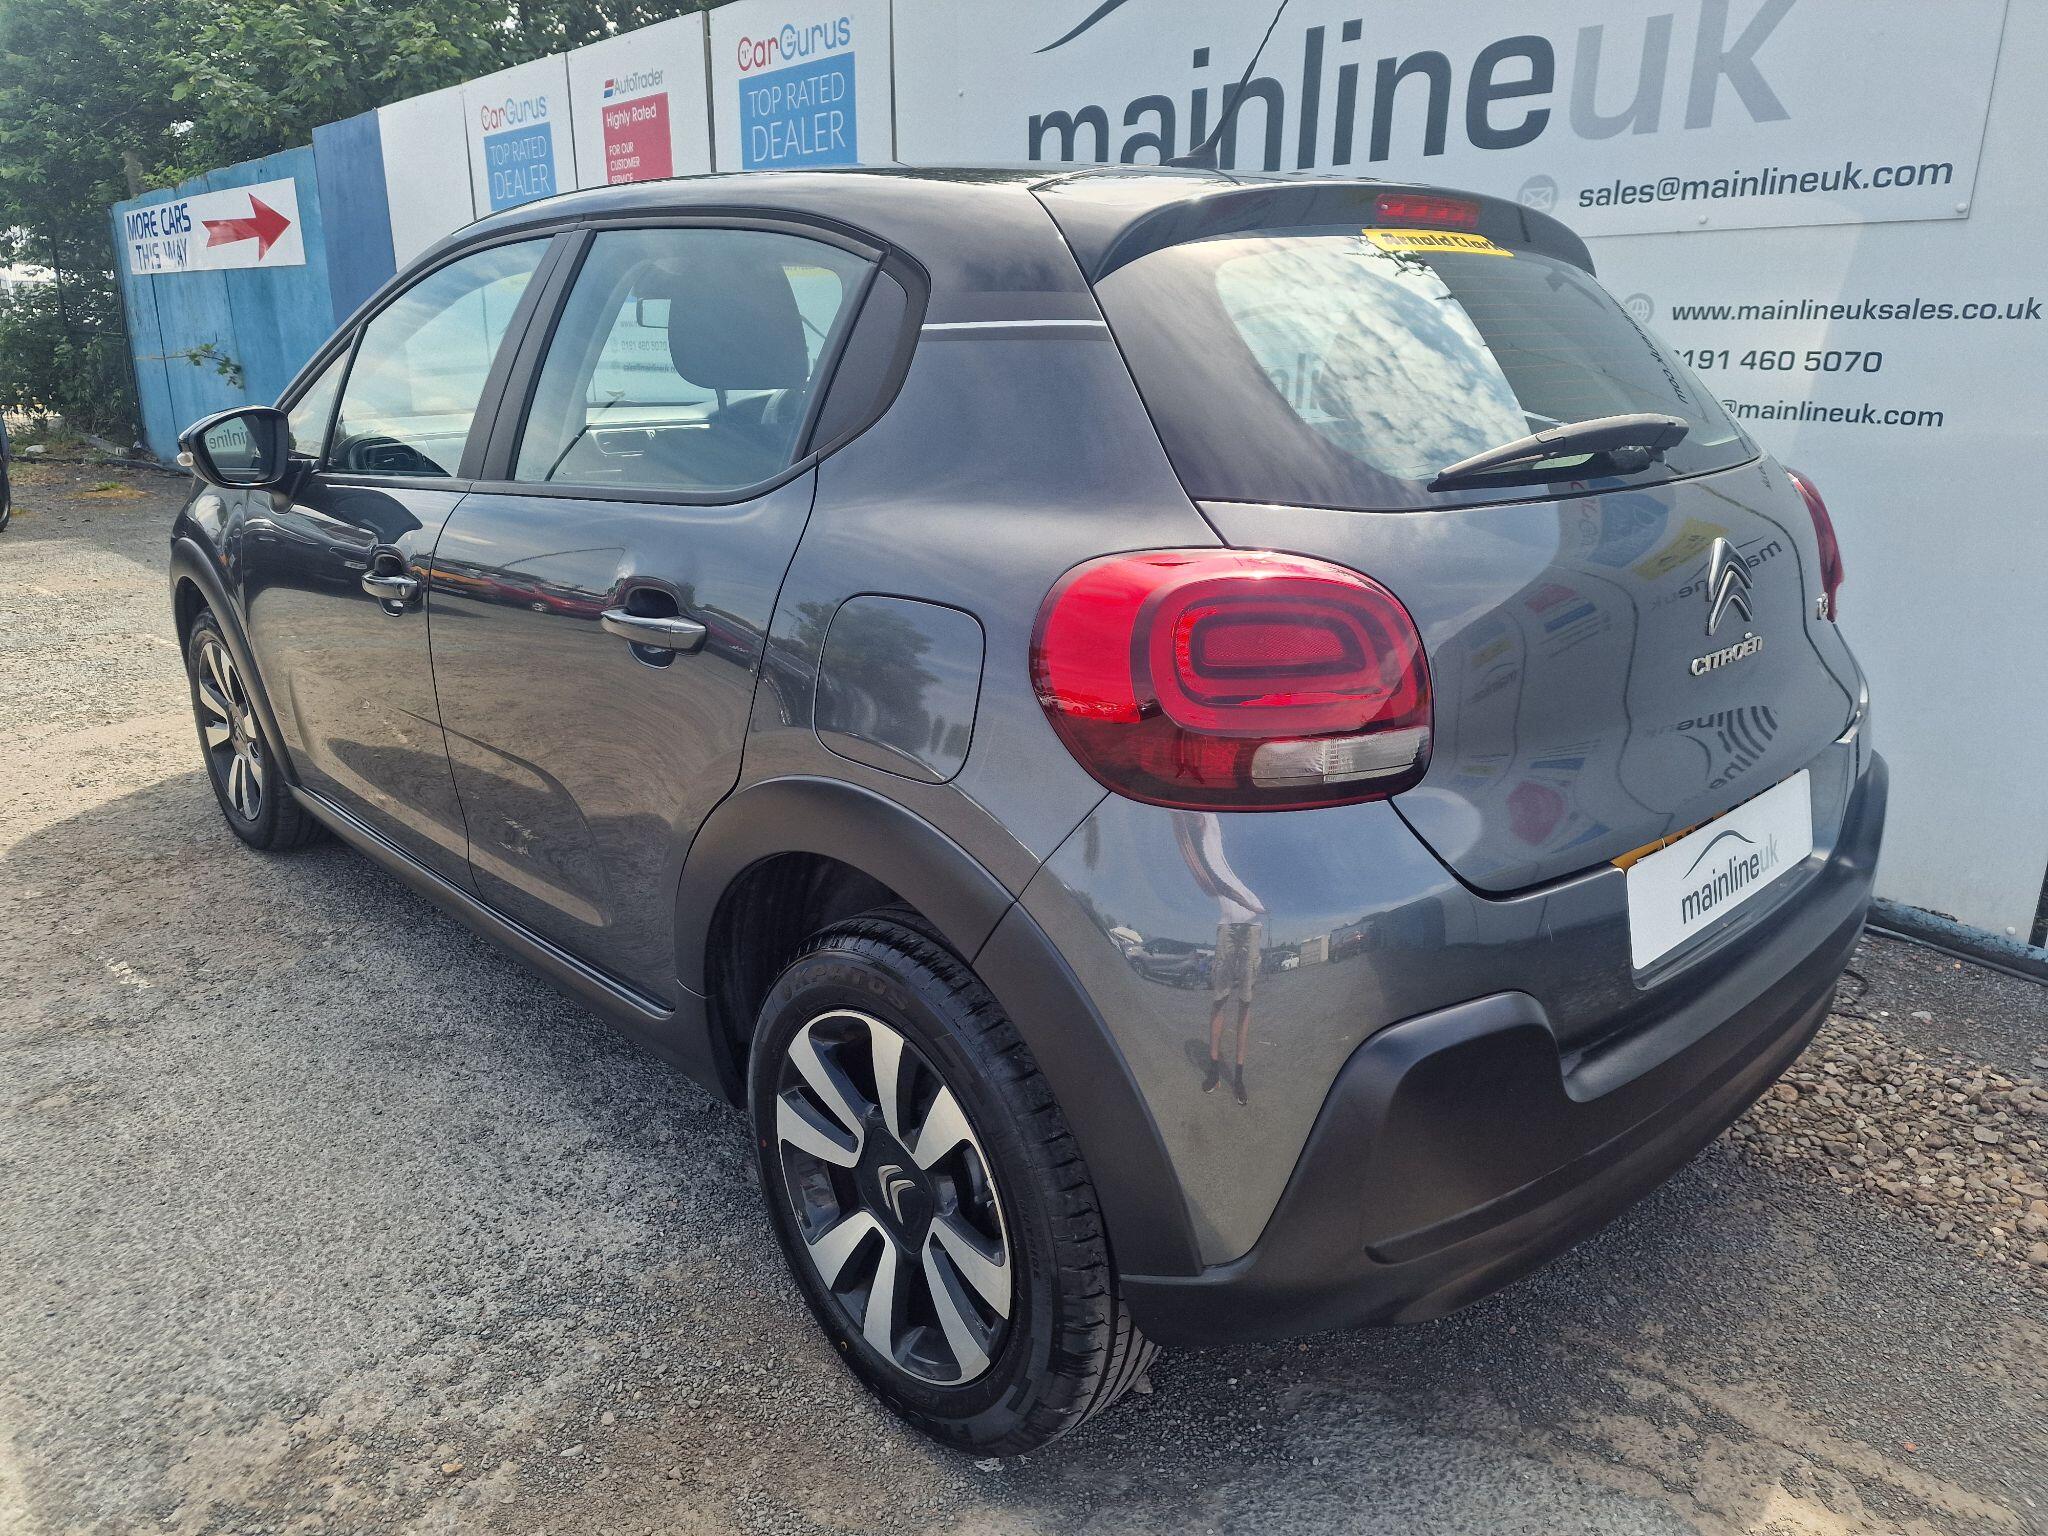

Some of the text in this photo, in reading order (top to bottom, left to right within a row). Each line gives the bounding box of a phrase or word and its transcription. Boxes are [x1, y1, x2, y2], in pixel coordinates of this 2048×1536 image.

[738, 17, 850, 71] CarGurus
[614, 69, 664, 95] AutoTrader
[747, 72, 845, 118] TOP RATED
[480, 96, 547, 131] CarGurus
[606, 102, 657, 130] Highly Rated
[489, 135, 547, 166] TOP RATED
[608, 141, 634, 156] FOR OUR
[752, 110, 846, 162] DEALER
[610, 156, 641, 172] CUSTOMER
[494, 163, 551, 200] DEALER
[1579, 161, 1953, 208] sales@mainlineuk.com
[126, 202, 192, 241] MORE CARS
[135, 242, 162, 270] THIS
[1672, 296, 2043, 321] www.mainlineuksales.co.uk
[1674, 349, 1883, 373] 191 460 5070
[1681, 832, 1780, 925] mainlineuk
